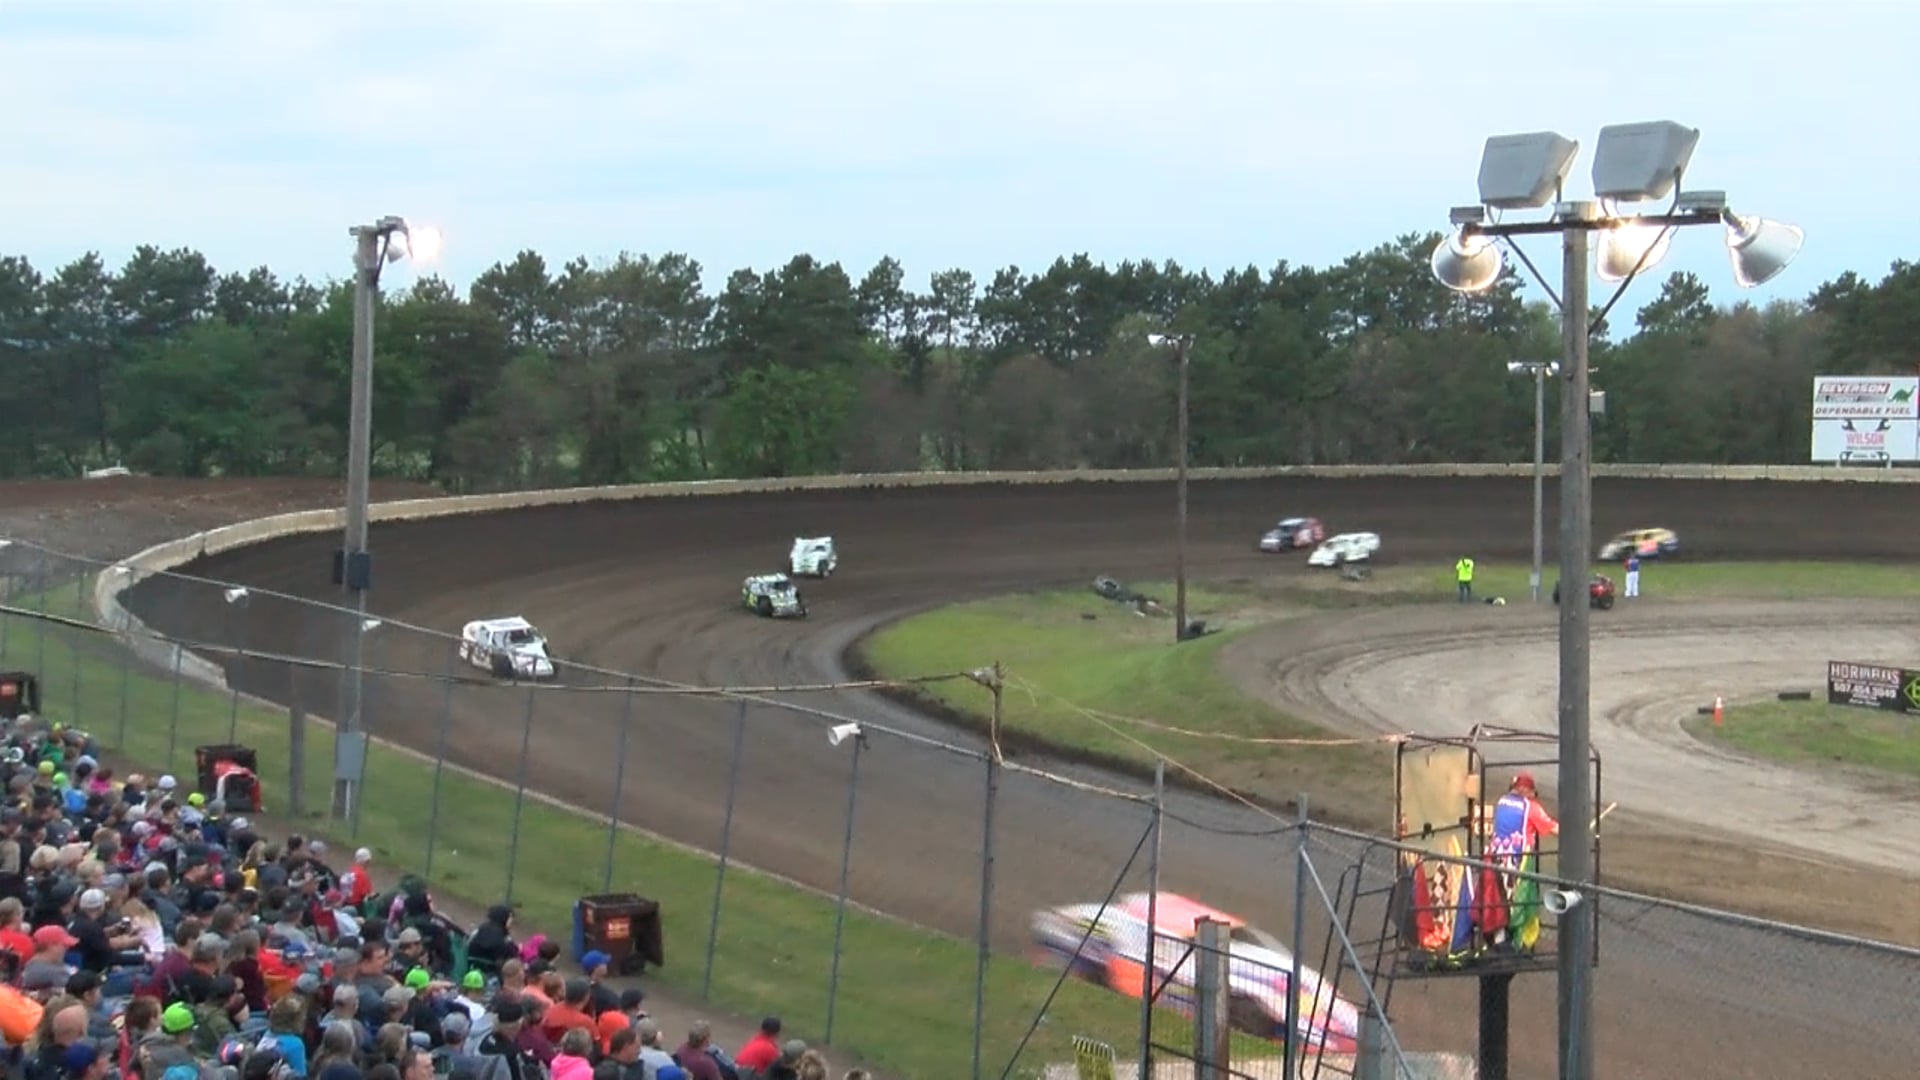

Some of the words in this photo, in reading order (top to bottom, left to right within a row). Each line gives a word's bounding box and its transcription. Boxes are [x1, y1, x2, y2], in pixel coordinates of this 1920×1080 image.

[1821, 383, 1887, 394] SEVERSON
[1815, 407, 1882, 415] DEPENDABLE
[1885, 407, 1911, 415] FUEL
[1846, 432, 1884, 445] WILSON
